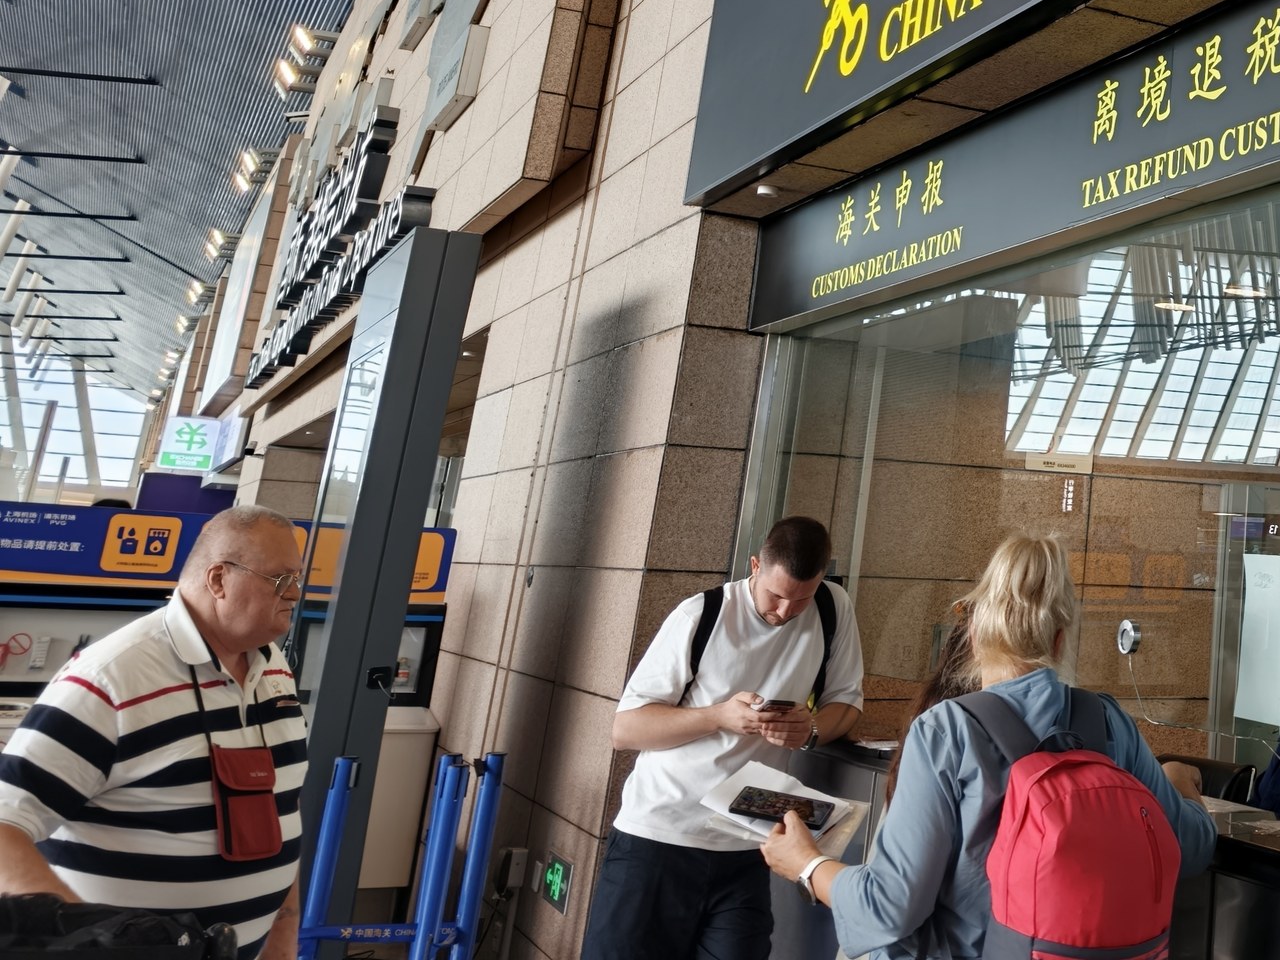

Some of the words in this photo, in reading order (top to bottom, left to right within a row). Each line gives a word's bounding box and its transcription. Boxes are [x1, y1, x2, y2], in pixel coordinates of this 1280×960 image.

[835, 159, 944, 247] 海关申报
[1081, 172, 1121, 208] TAX
[1124, 137, 1214, 195] REFUND
[811, 260, 866, 299] CUSTOMS
[867, 226, 964, 280] DECLARATION
